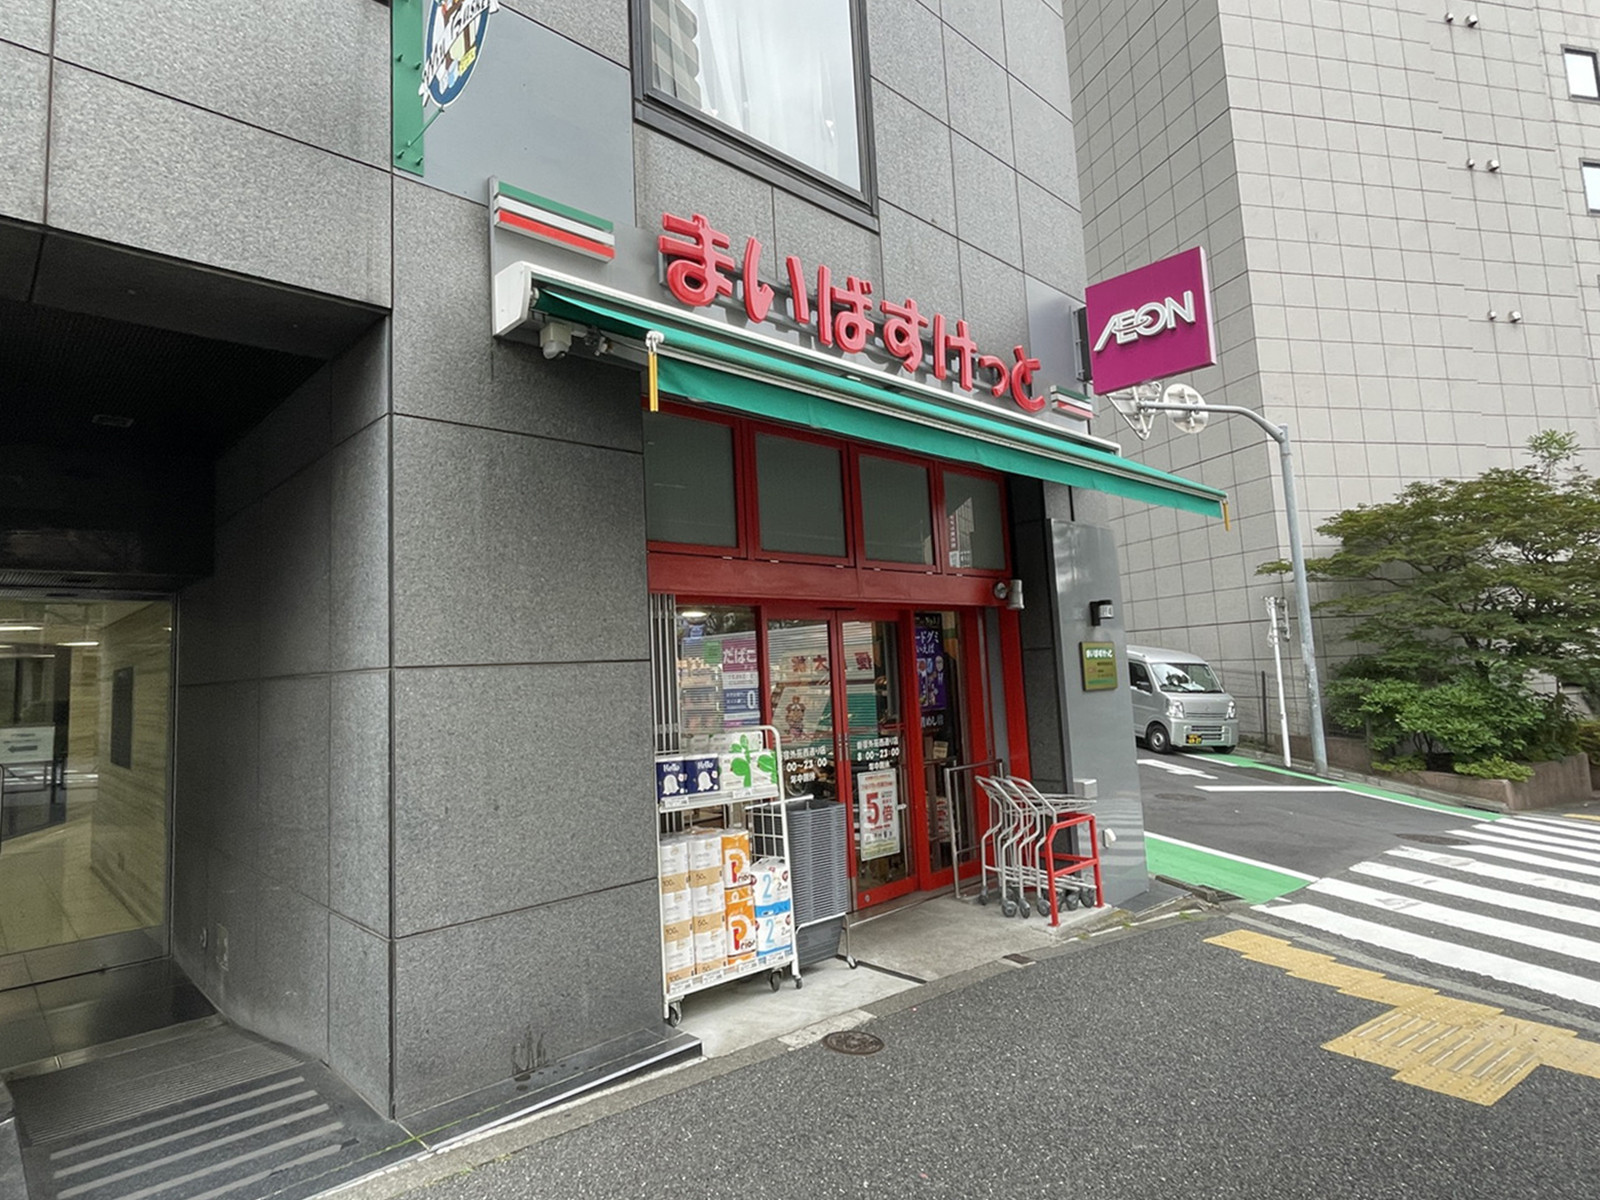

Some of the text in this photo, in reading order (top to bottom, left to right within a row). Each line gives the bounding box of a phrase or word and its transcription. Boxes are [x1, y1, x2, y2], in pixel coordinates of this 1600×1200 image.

[658, 213, 1046, 413] まいばすけっと
[1093, 290, 1196, 352] AEON
